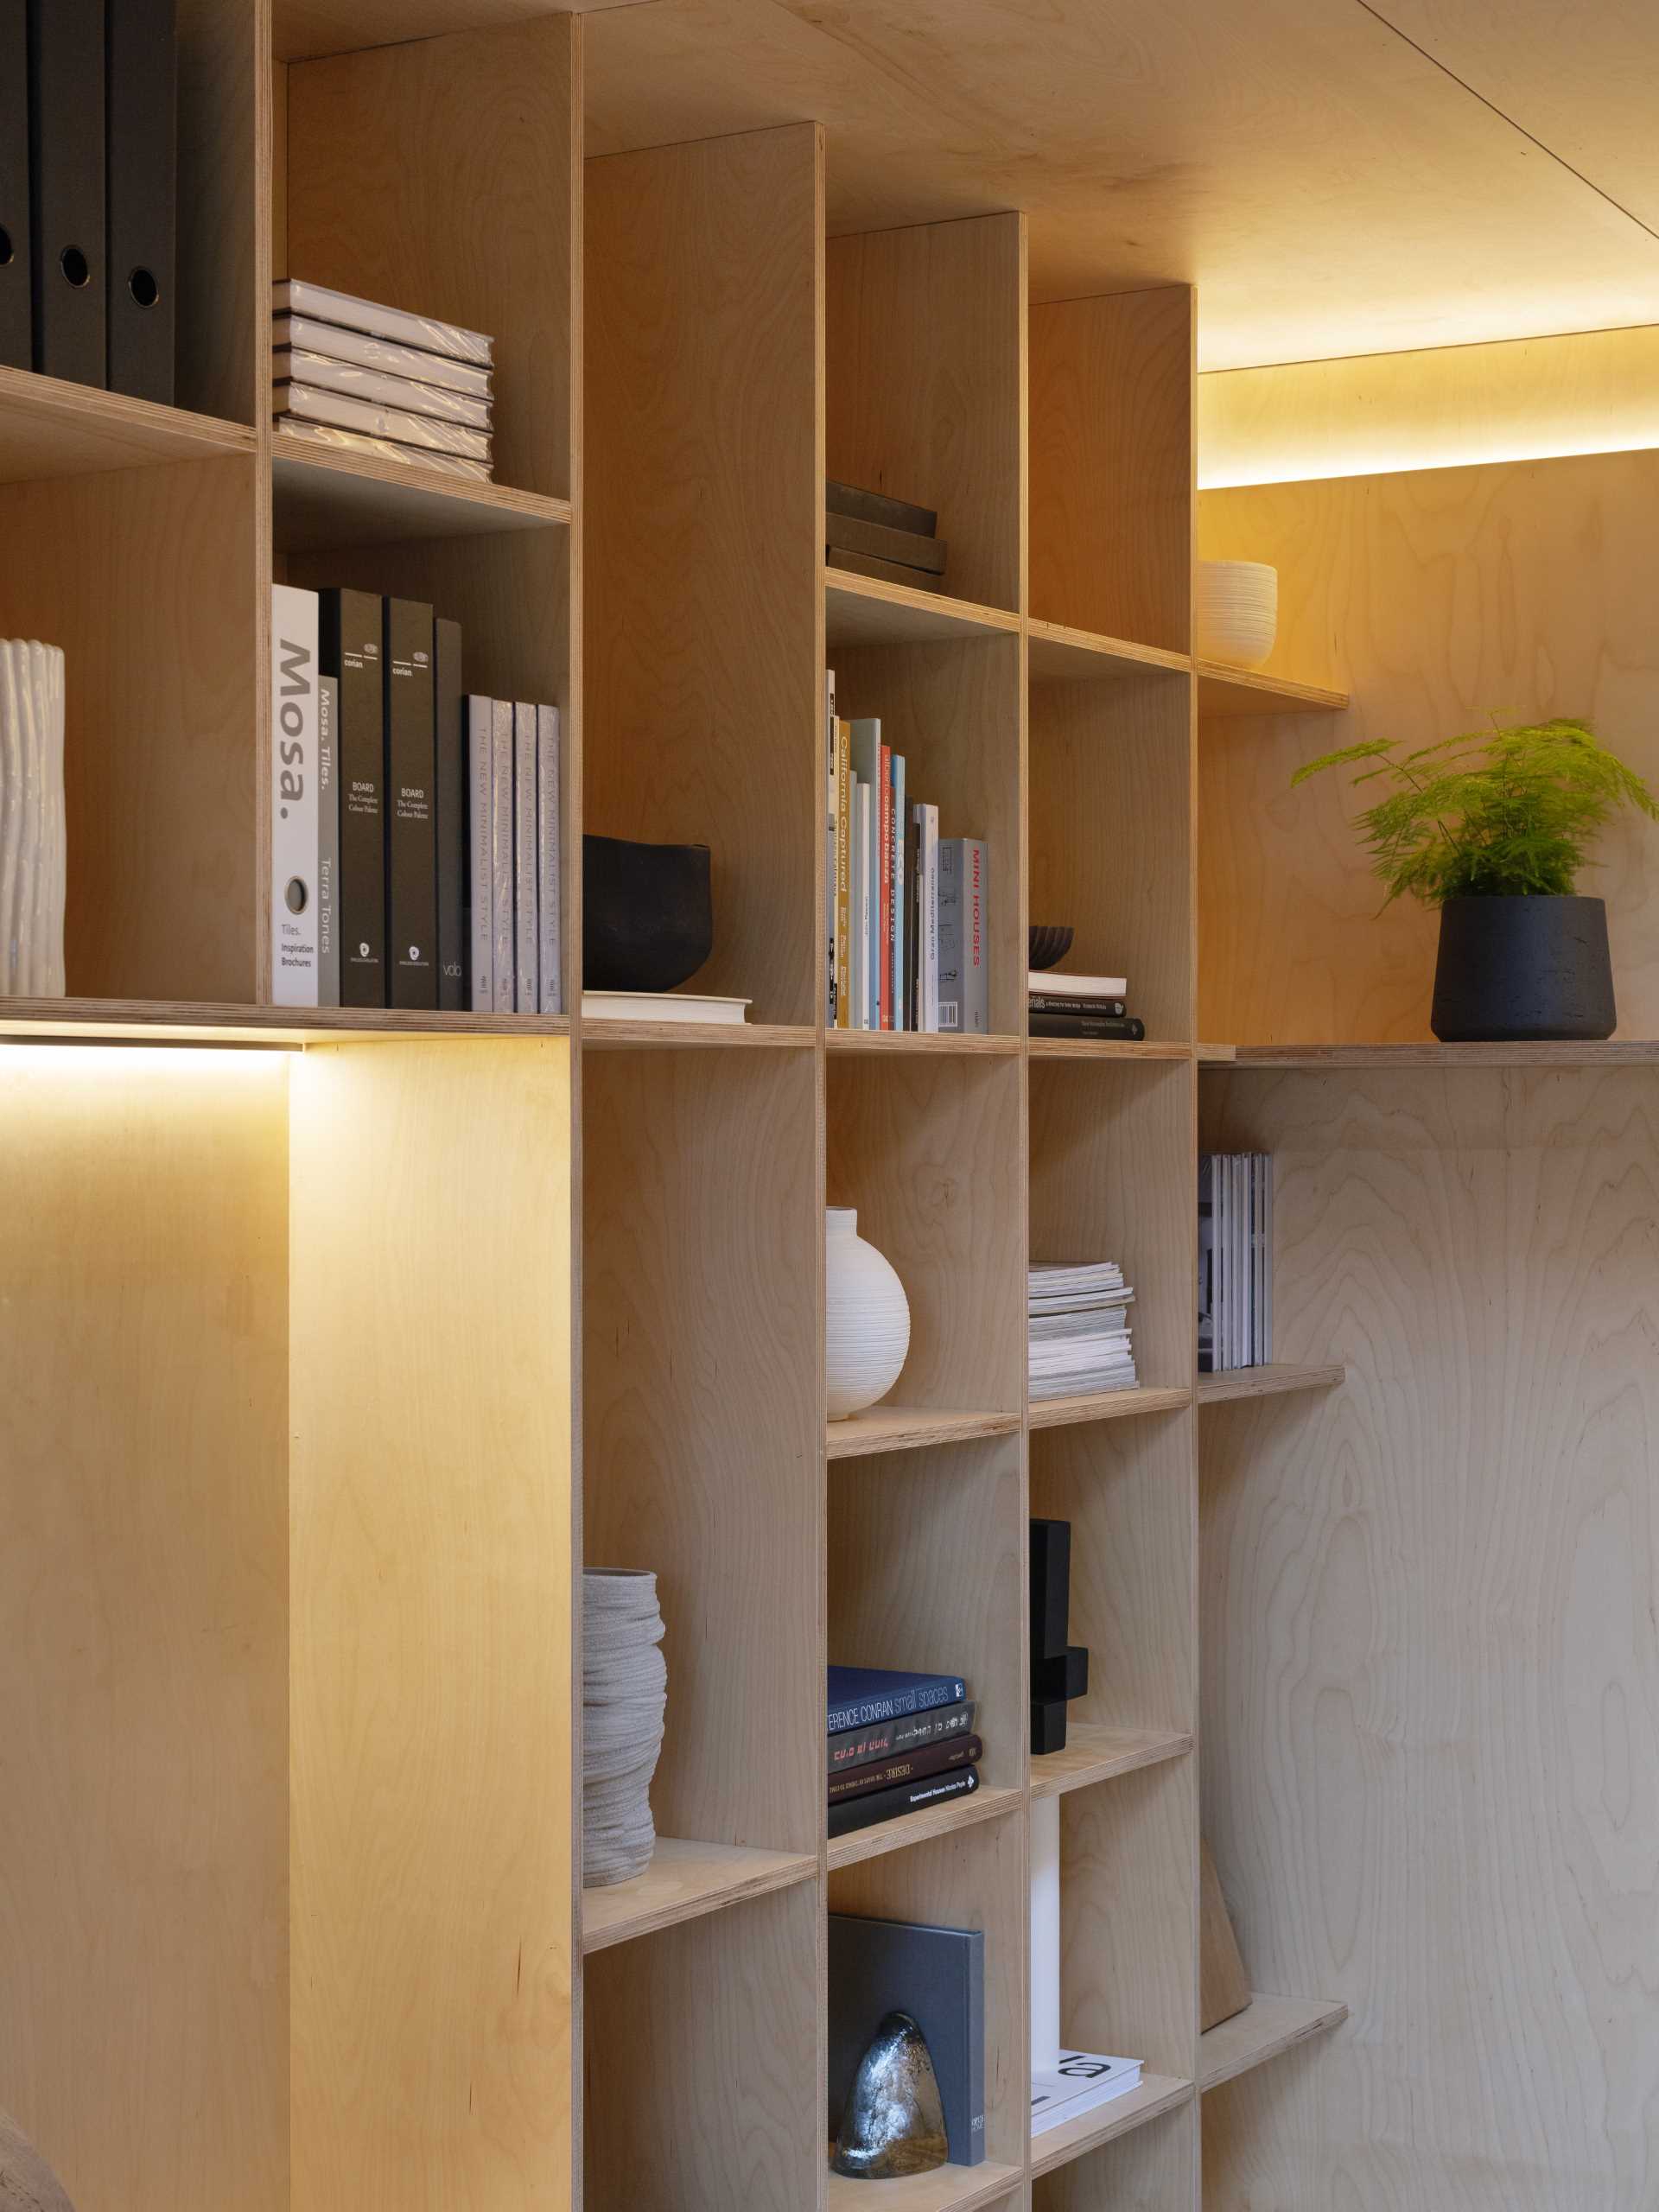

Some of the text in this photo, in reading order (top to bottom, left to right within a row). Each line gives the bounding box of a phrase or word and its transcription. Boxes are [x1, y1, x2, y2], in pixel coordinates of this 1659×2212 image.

[279, 639, 311, 819] Mosa.
[320, 688, 331, 791] Mosa. Tiles.
[353, 781, 374, 792] BOARD
[401, 787, 424, 798] BOARD
[479, 760, 487, 795] NEW
[321, 857, 332, 954] Terra Tones
[828, 1707, 859, 1732] ERENCE
[860, 1700, 893, 1723] CONRAN
[894, 1691, 916, 1713] small
[919, 1687, 948, 1708] spaces
